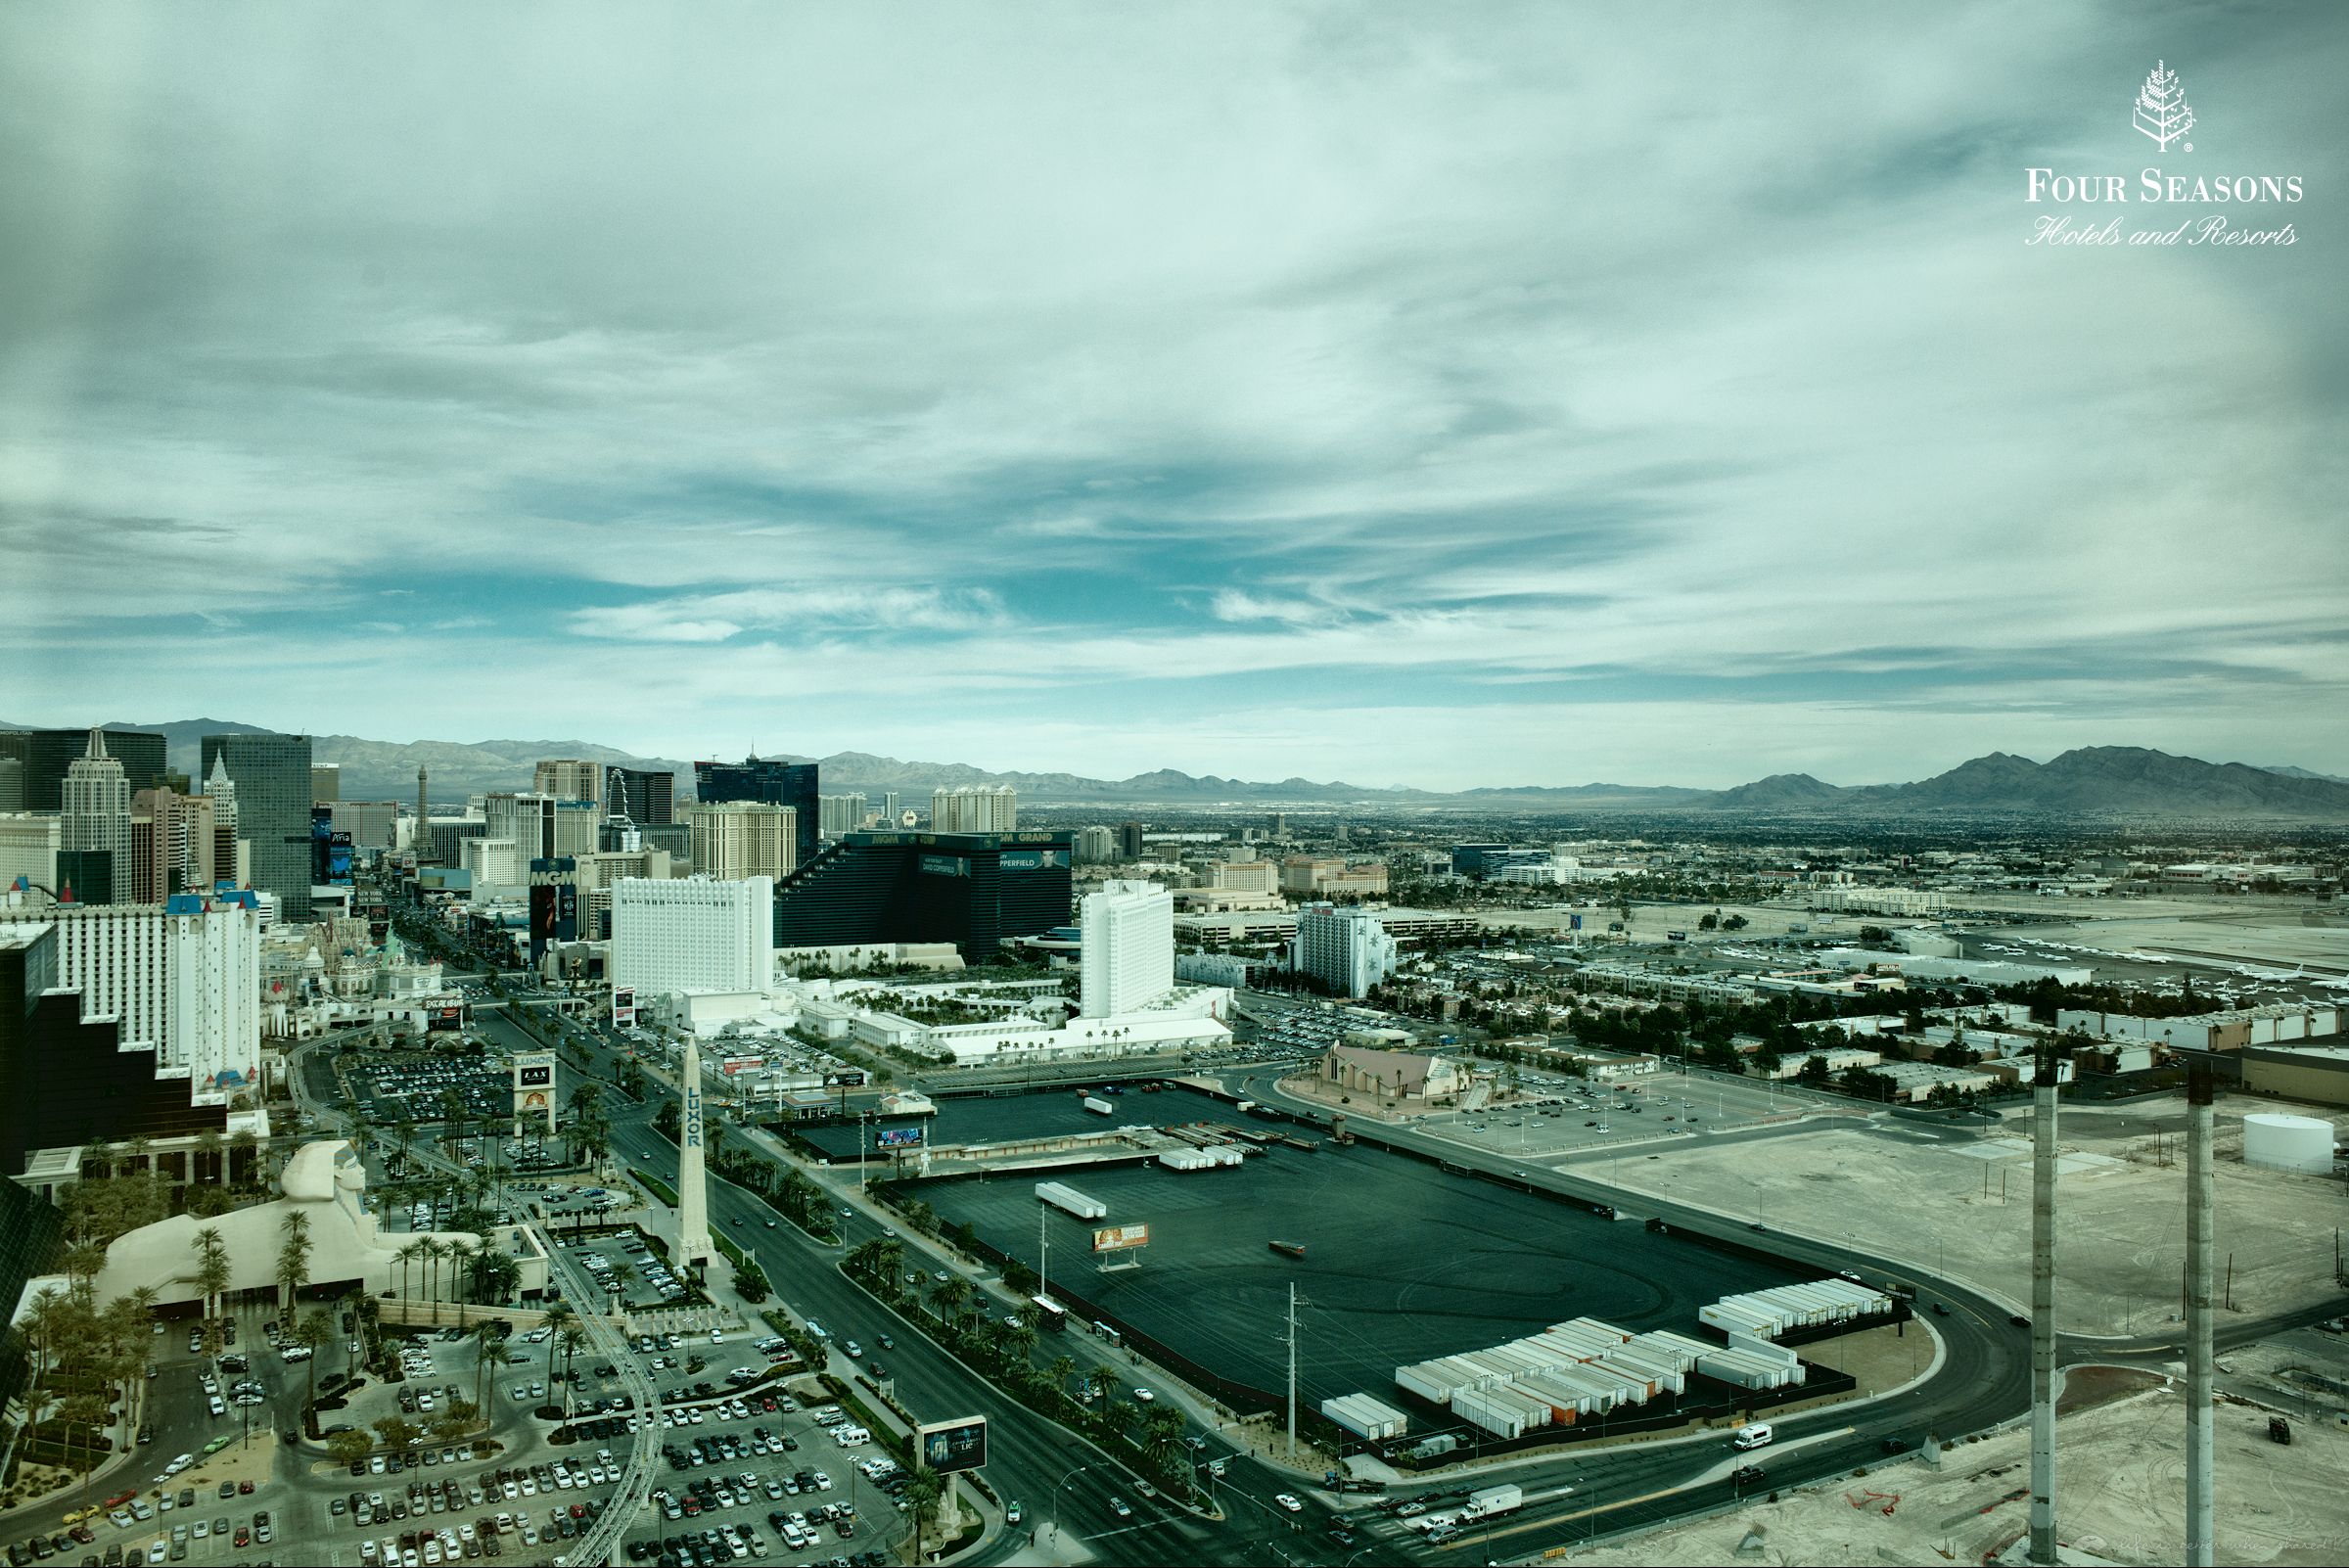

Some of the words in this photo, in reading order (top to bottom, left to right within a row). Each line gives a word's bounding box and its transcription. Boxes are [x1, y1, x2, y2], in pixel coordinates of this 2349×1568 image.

[872, 835, 898, 844] MGM
[530, 870, 576, 886] MGM
[426, 999, 464, 1009] EXCALIBUR
[687, 1086, 702, 1146] LUXOR
